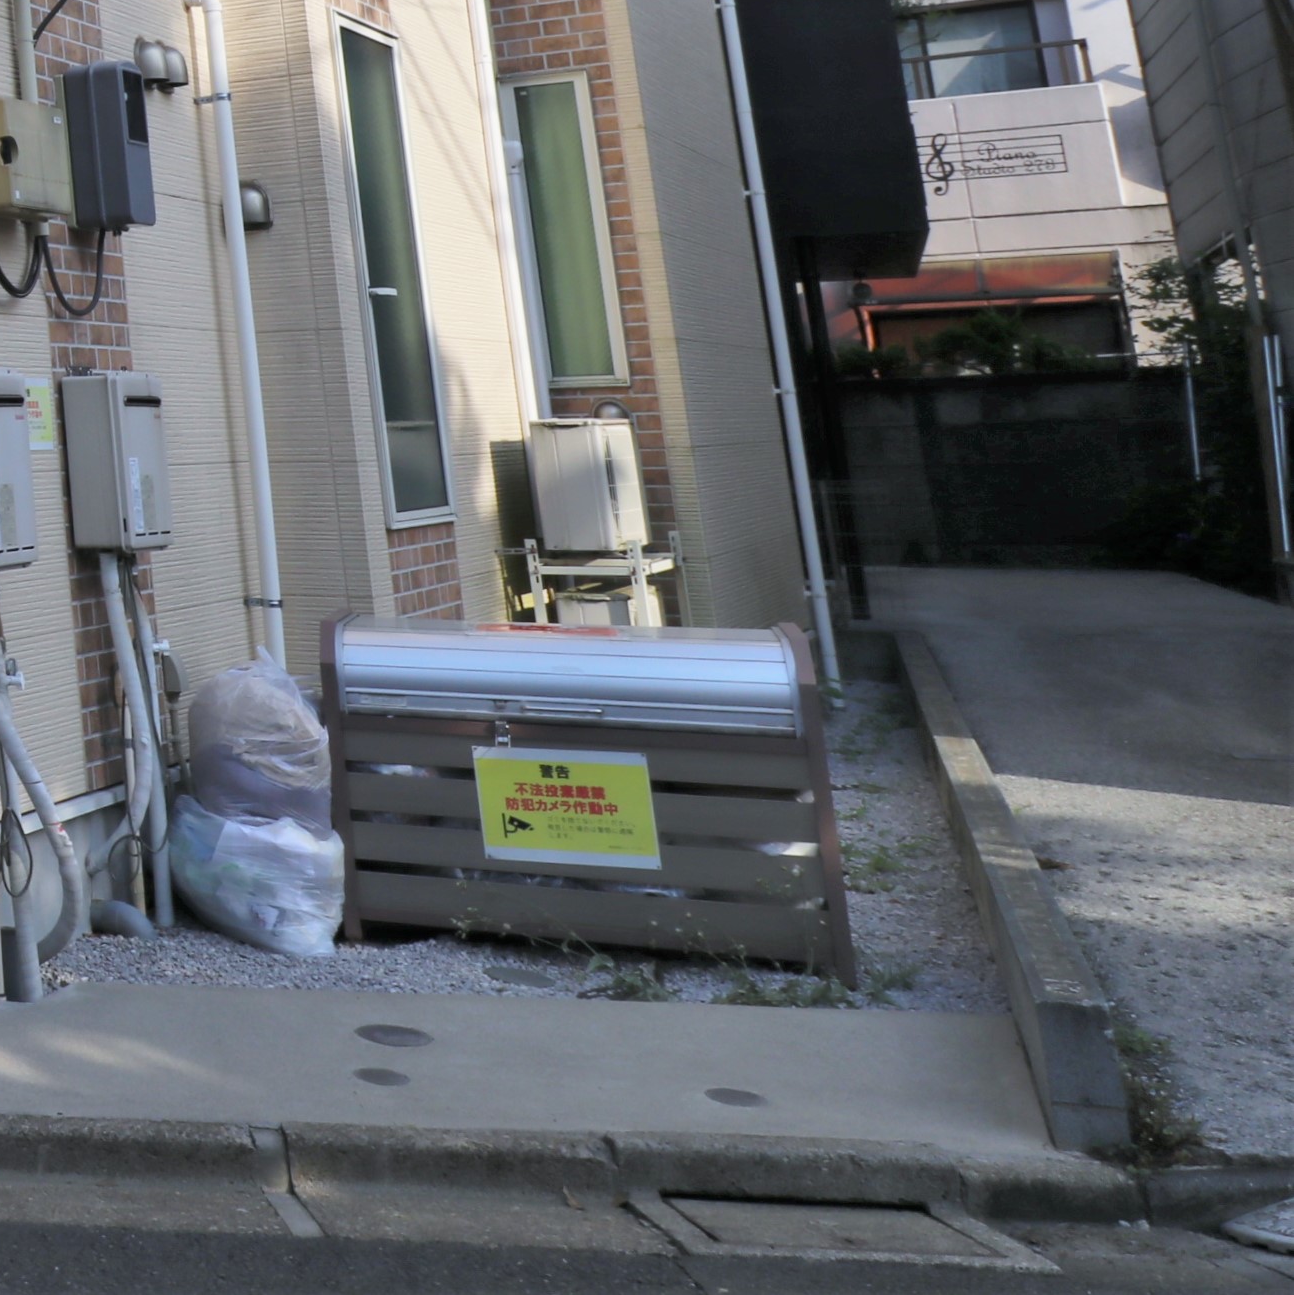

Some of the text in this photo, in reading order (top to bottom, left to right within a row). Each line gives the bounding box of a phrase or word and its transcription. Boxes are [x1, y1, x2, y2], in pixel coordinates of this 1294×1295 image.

[978, 142, 1038, 162] Piano
[961, 159, 1016, 177] Studio
[538, 764, 570, 779] 警告
[505, 797, 619, 816] 防犯カメラ作動中
